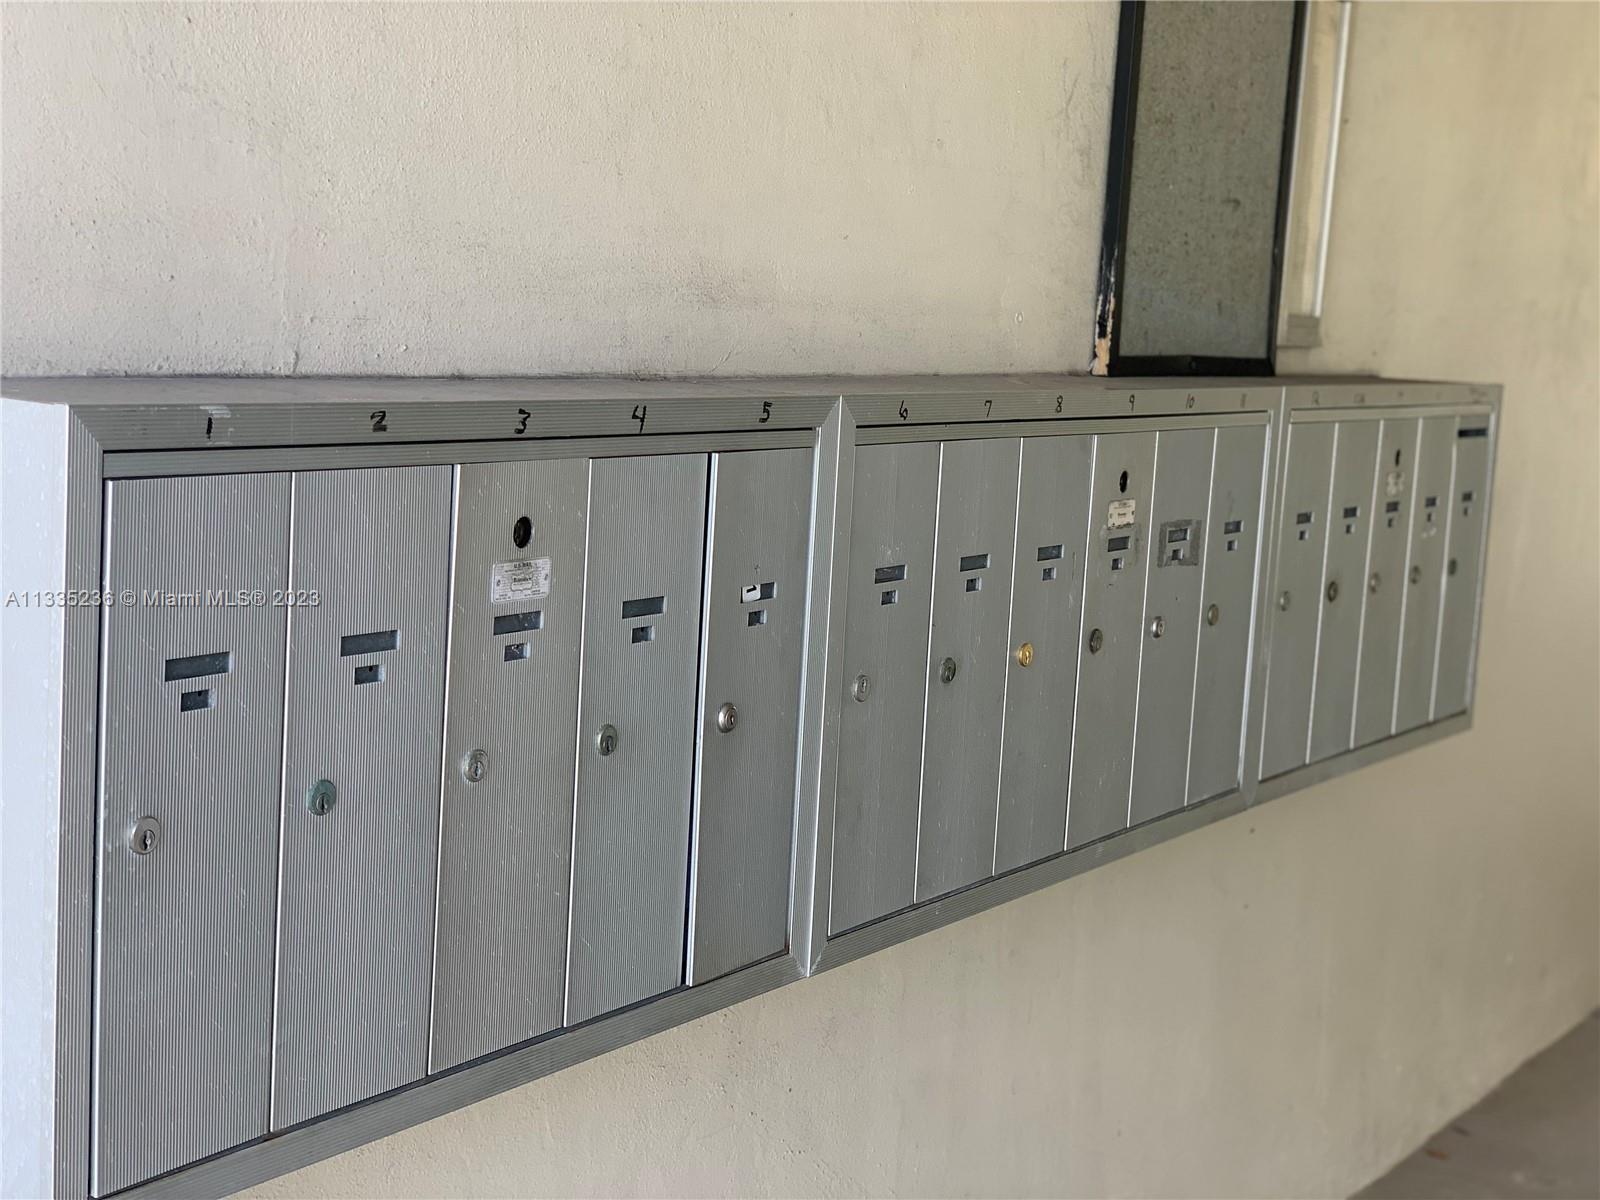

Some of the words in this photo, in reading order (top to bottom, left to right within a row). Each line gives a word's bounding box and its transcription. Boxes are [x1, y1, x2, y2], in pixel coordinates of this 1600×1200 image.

[205, 416, 214, 441] 1
[369, 410, 388, 432] 2
[514, 408, 532, 434] 3
[631, 404, 648, 434] 4
[758, 400, 773, 424] 5
[898, 399, 910, 421] 6
[983, 399, 993, 418] 7
[1055, 394, 1064, 413] 8
[1128, 394, 1136, 412] 9
[1185, 392, 1195, 409] 10
